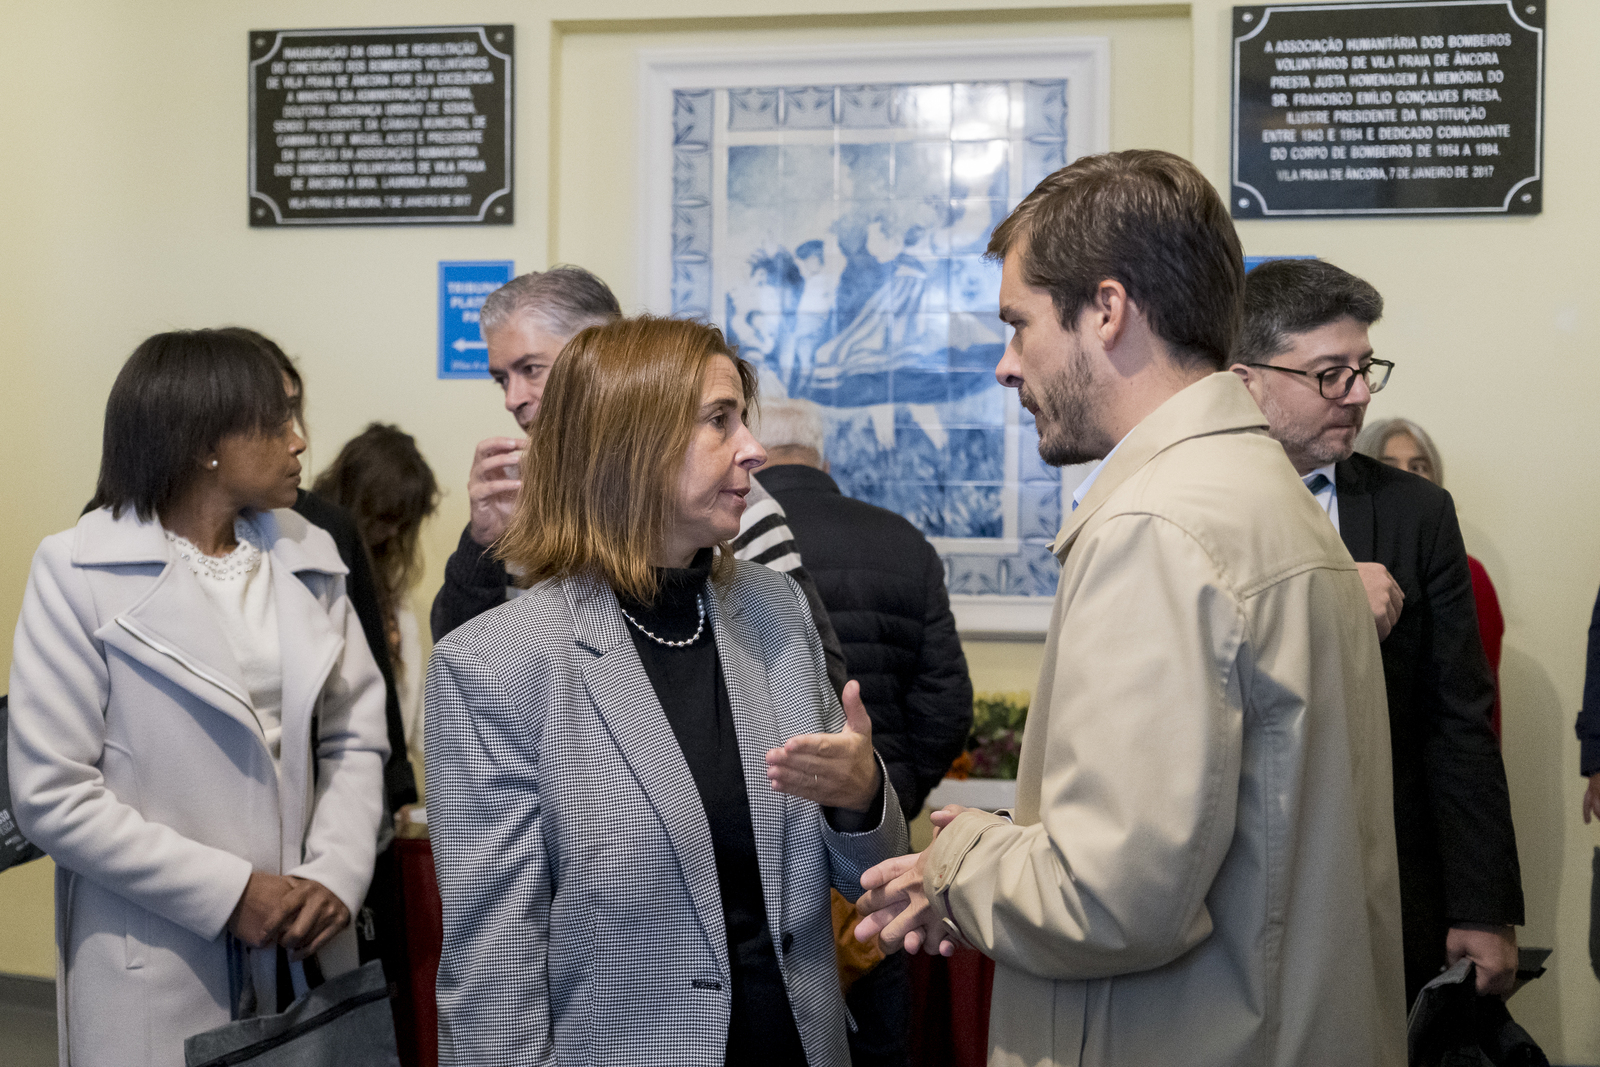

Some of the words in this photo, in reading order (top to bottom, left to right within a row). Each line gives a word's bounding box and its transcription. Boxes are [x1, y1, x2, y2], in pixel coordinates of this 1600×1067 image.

[1264, 40, 1273, 52] A
[1276, 36, 1342, 54] ASSOCIAÇÃO
[1421, 36, 1444, 49] DOS
[1448, 34, 1512, 48] BOMBEIROS
[1352, 56, 1366, 69] DE
[1370, 56, 1395, 68] VILA
[1398, 55, 1431, 68] PRAIA
[1434, 55, 1449, 67] DE
[1453, 51, 1499, 67] ÂNCORA
[1270, 76, 1310, 89] PRESTA
[1313, 75, 1346, 88] JUSTA
[1349, 73, 1417, 87] HOMENAGEM
[1488, 72, 1504, 85] DO
[1293, 92, 1352, 106] FRANCISCO
[1396, 90, 1459, 106] GONÇALVES
[1286, 111, 1330, 125] ILUSTRE
[1333, 109, 1397, 124] PRESIDENTE
[1401, 109, 1417, 122] DA
[1421, 105, 1486, 124] INSTITUIÇÃO
[1262, 129, 1296, 142] ENTRE
[1327, 128, 1335, 141] E
[1366, 128, 1374, 141] E
[1378, 127, 1433, 140] DEDICADO
[1436, 125, 1510, 139] COMANDANTE
[1270, 147, 1286, 160] DO
[1290, 147, 1328, 160] CORPO
[1331, 146, 1346, 159] DE
[1350, 145, 1412, 159] BOMBEIROS
[1416, 145, 1432, 158] DE
[1462, 144, 1471, 157] A
[1277, 169, 1298, 181] VILA
[1300, 169, 1328, 181] PRAIA
[1330, 168, 1343, 180] DE
[1390, 168, 1395, 180] 7
[1396, 167, 1410, 179] DE
[1412, 167, 1452, 179] JANEIRO
[1454, 167, 1468, 179] DE
[1472, 166, 1494, 178] 2017
